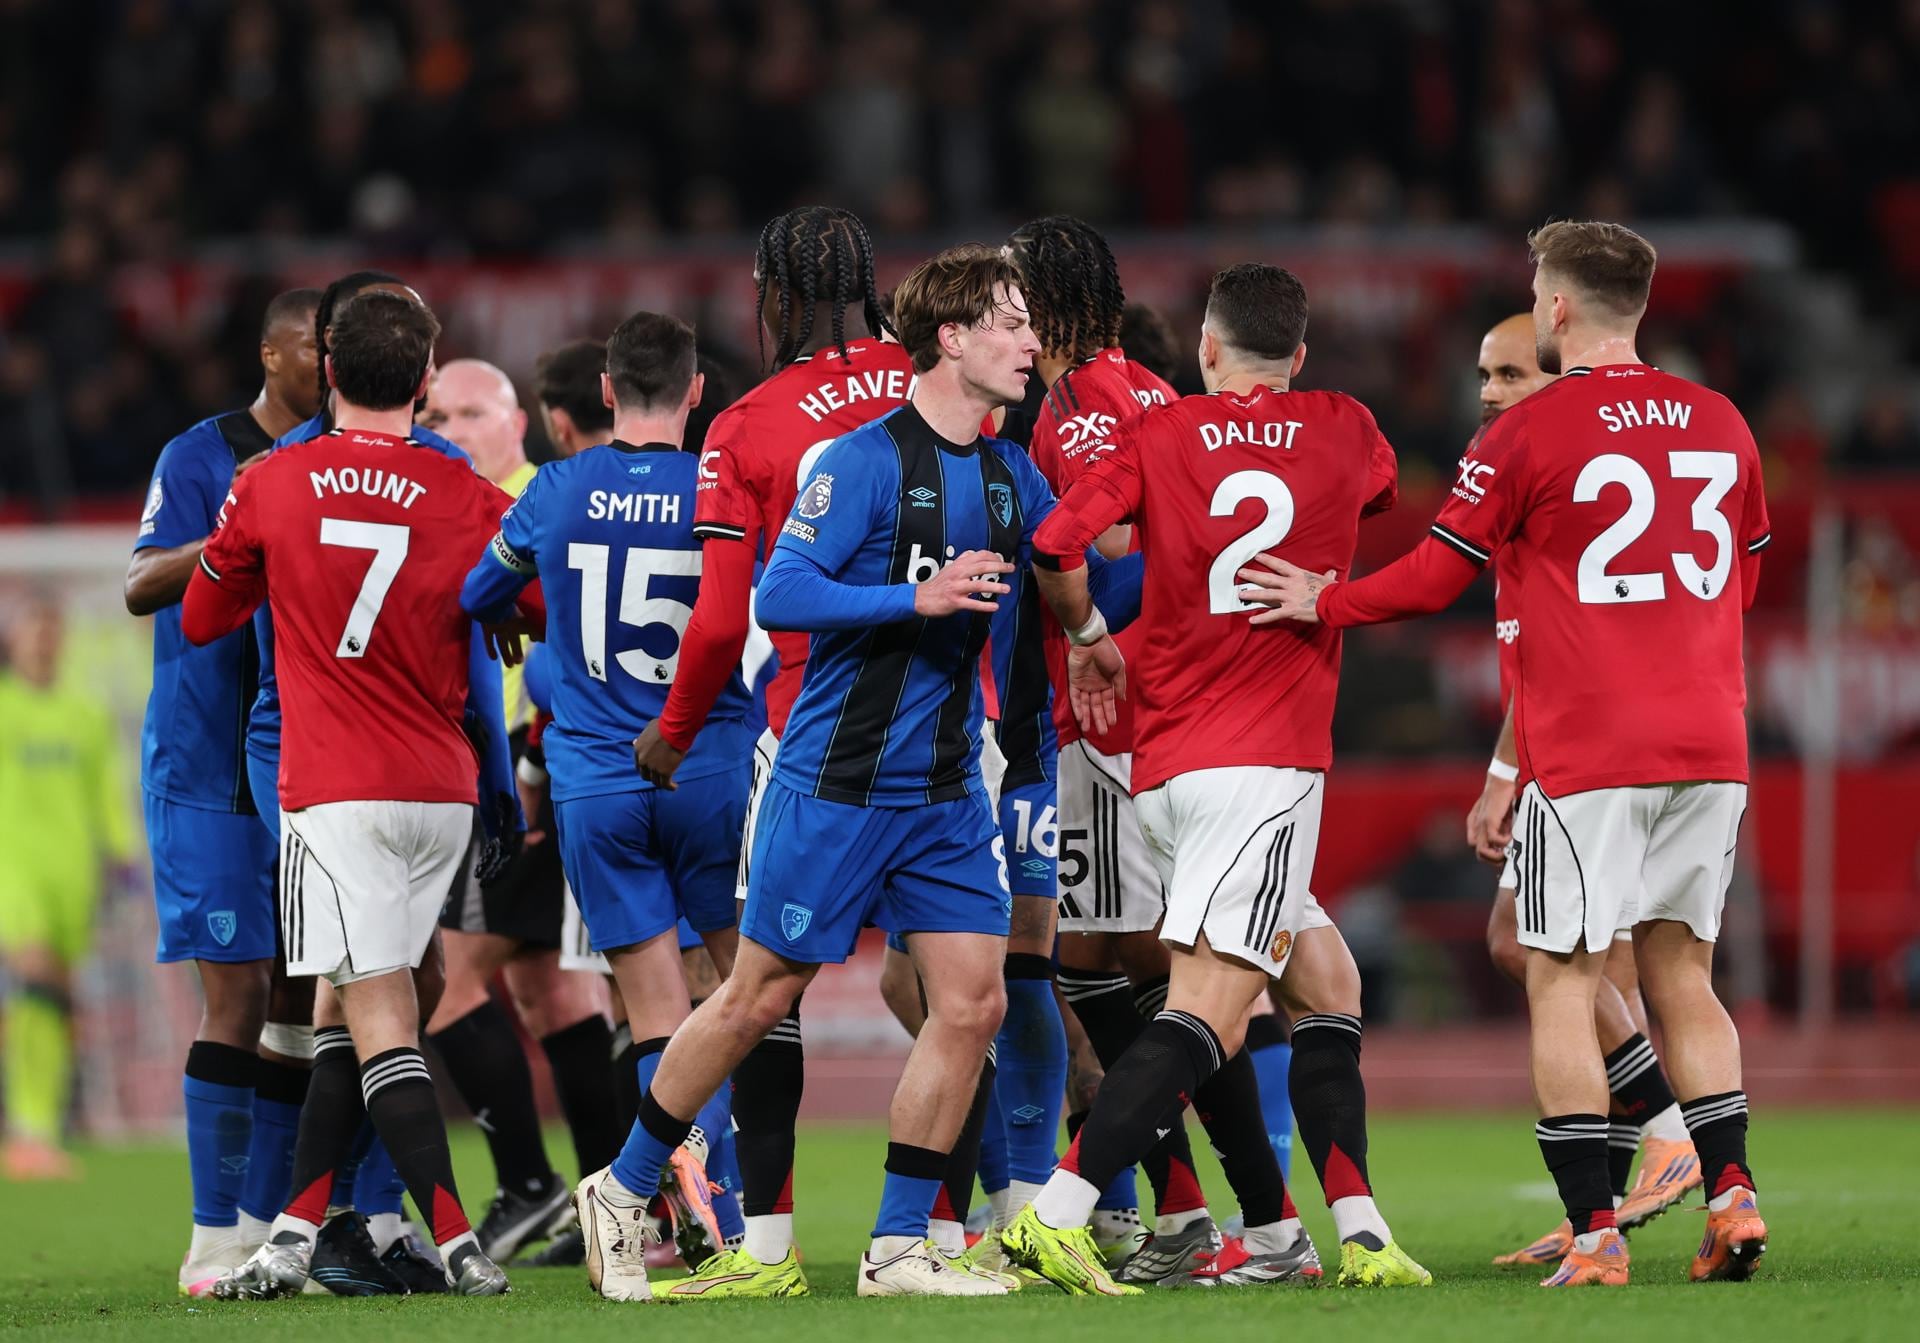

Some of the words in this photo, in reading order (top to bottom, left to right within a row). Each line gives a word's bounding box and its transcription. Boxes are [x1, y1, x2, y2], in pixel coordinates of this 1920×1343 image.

[1199, 420, 1303, 452] DALOT
[1598, 399, 1692, 433] SHAW
[309, 466, 427, 509] MOUNT
[628, 465, 651, 474] AFCB
[587, 490, 680, 524] SMITH
[1572, 450, 1739, 604] 23
[1209, 470, 1295, 614] 2
[319, 517, 411, 659] 7
[568, 542, 703, 685] 15
[1013, 799, 1058, 858] 16
